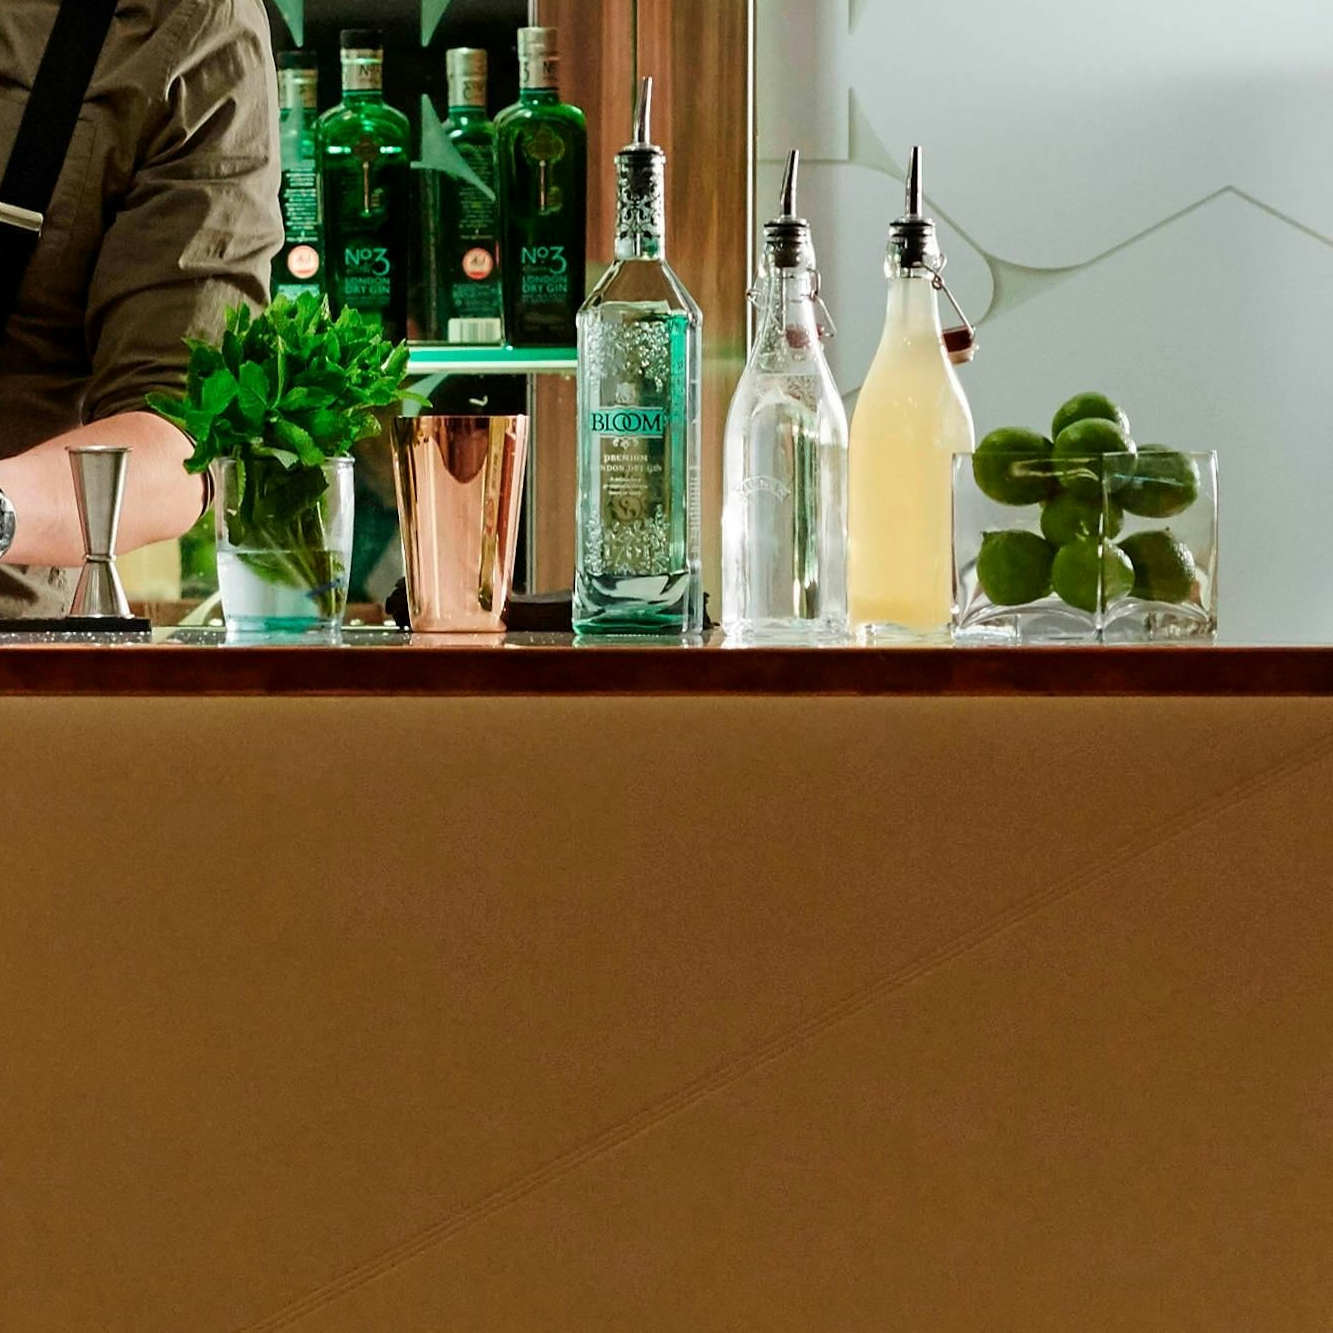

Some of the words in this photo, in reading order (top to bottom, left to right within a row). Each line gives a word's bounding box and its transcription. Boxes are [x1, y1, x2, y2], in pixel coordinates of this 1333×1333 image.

[546, 284, 567, 293] GIN
[591, 412, 661, 432] BLOOM
[604, 454, 648, 463] PREMIUM
